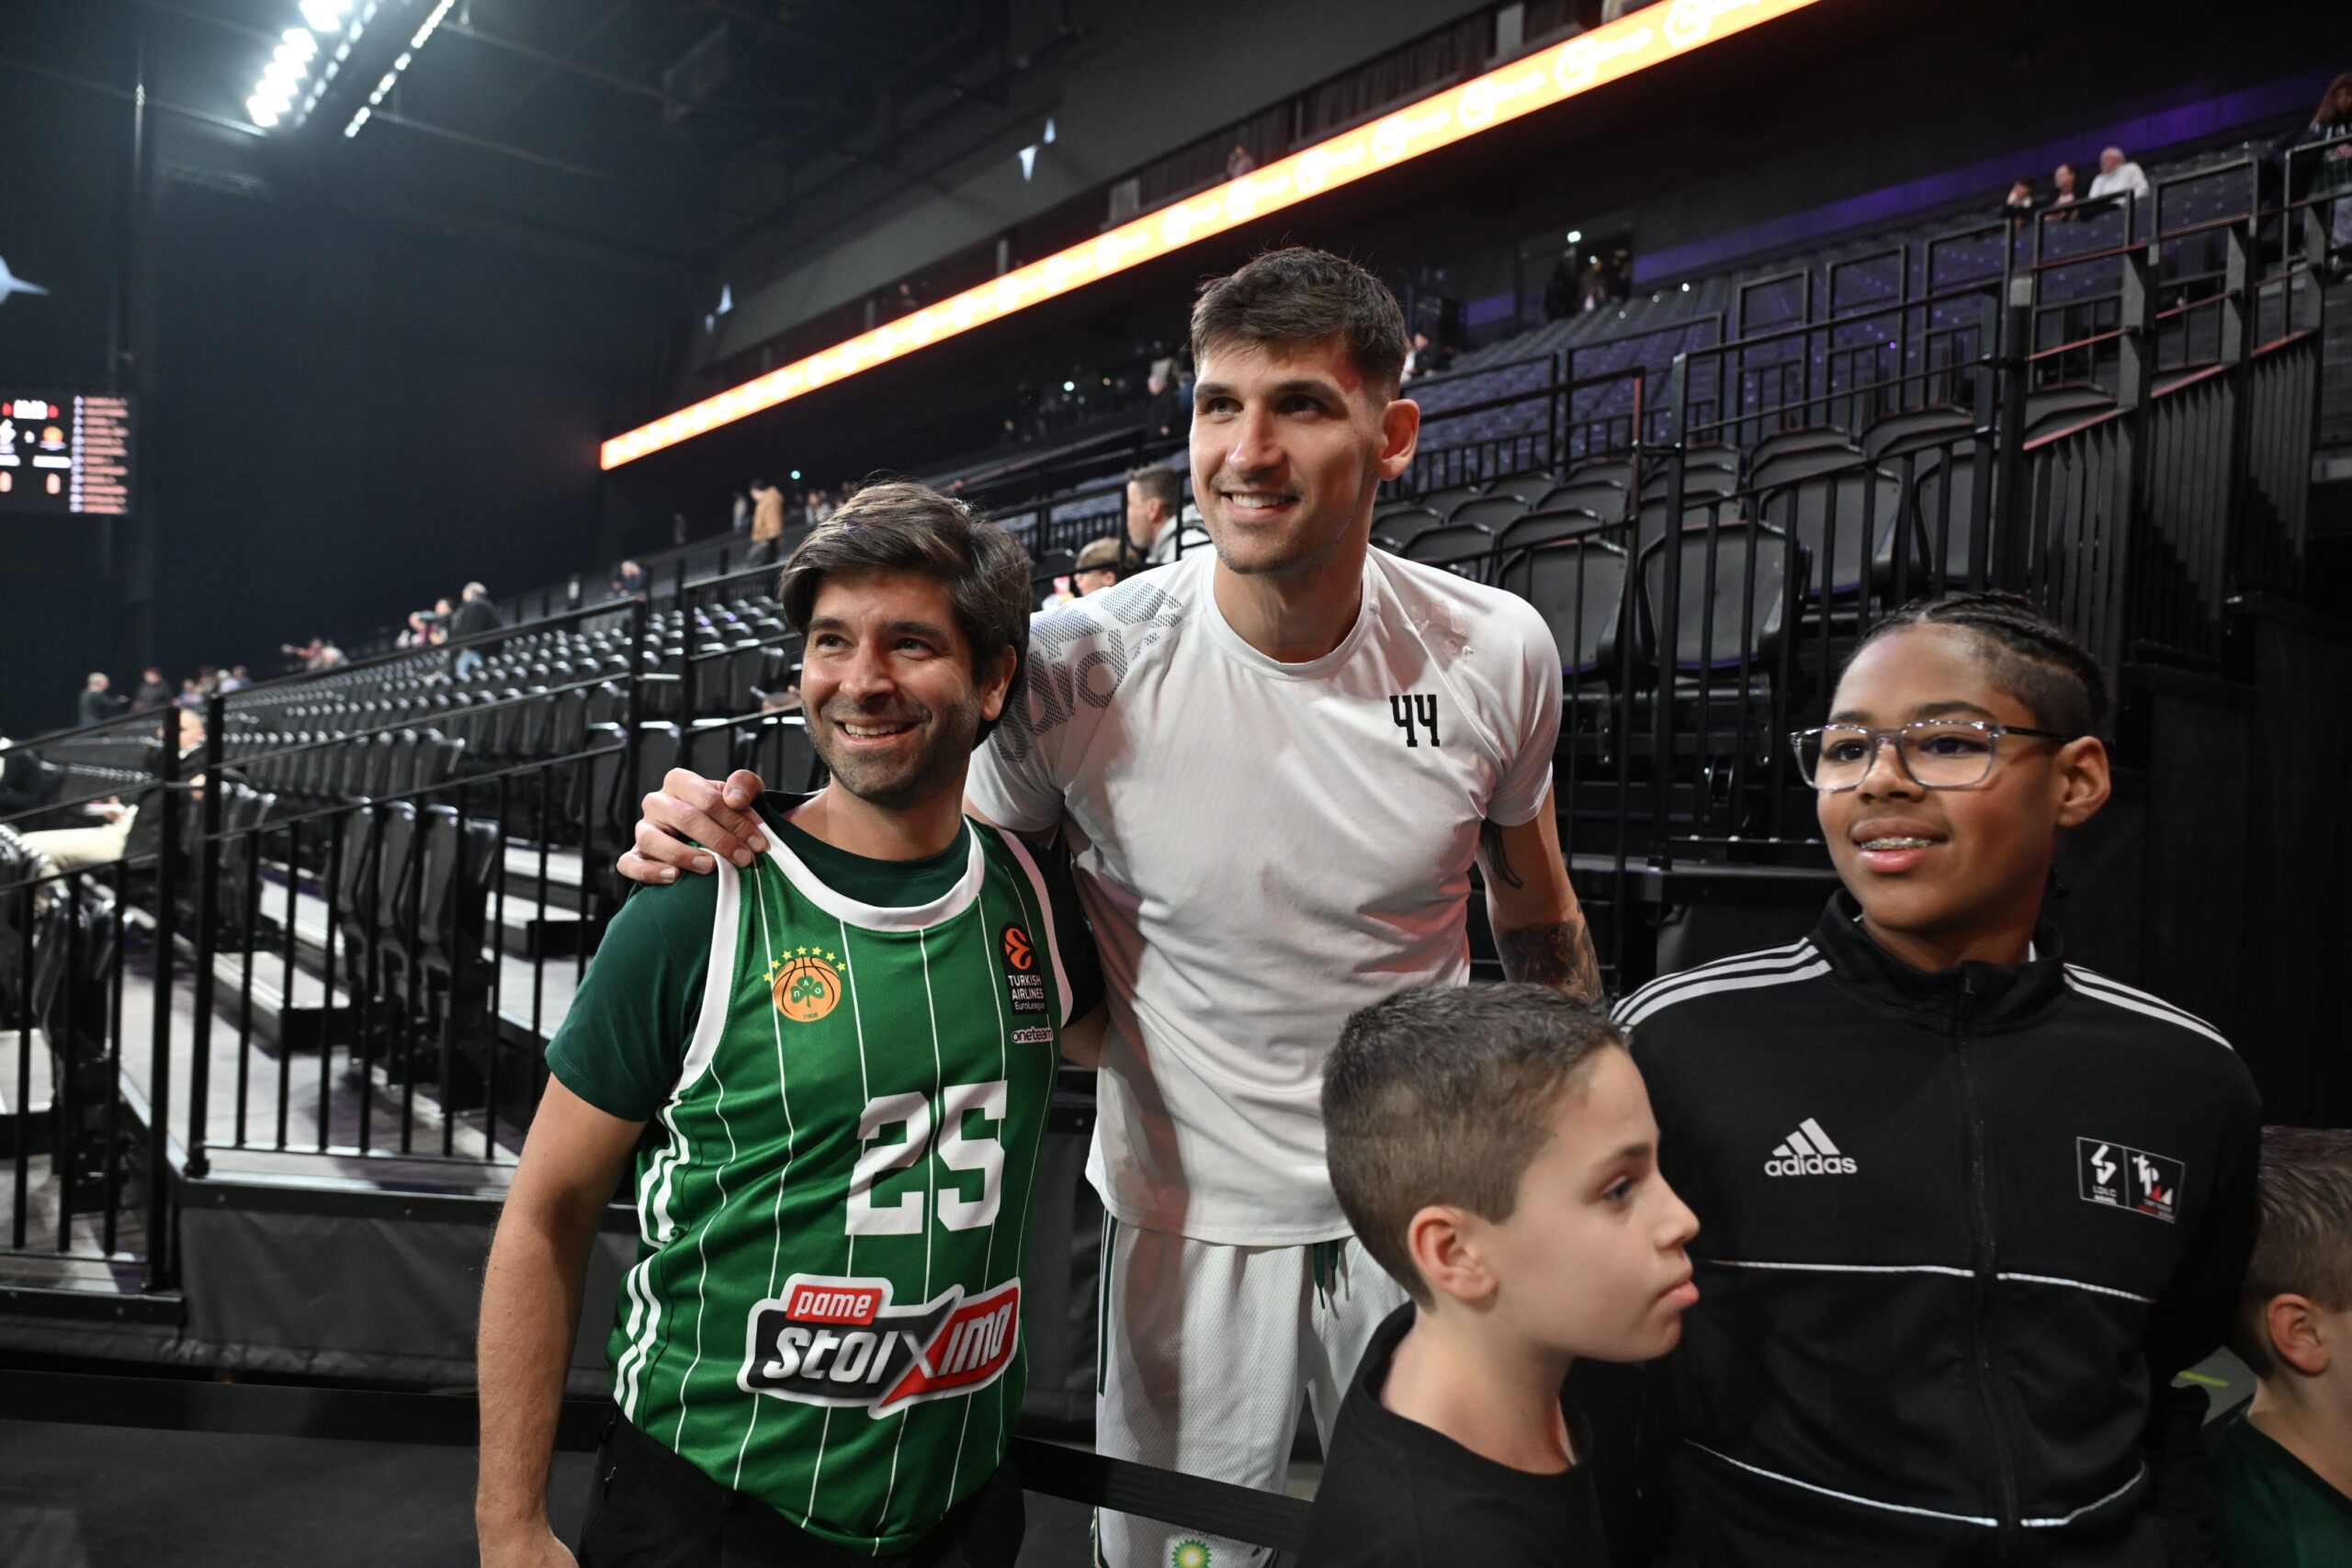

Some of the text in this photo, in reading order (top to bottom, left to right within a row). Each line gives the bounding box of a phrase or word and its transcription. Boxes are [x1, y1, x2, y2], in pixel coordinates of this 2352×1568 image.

[1389, 694, 1441, 747] 44
[1008, 975, 1042, 986] TURKISH
[1012, 987, 1044, 1000] AIRLINES
[1012, 1027, 1053, 1043] oneteam
[844, 1079, 1008, 1235] 25
[1764, 1154, 1858, 1177] adidas
[793, 1291, 872, 1317] pame
